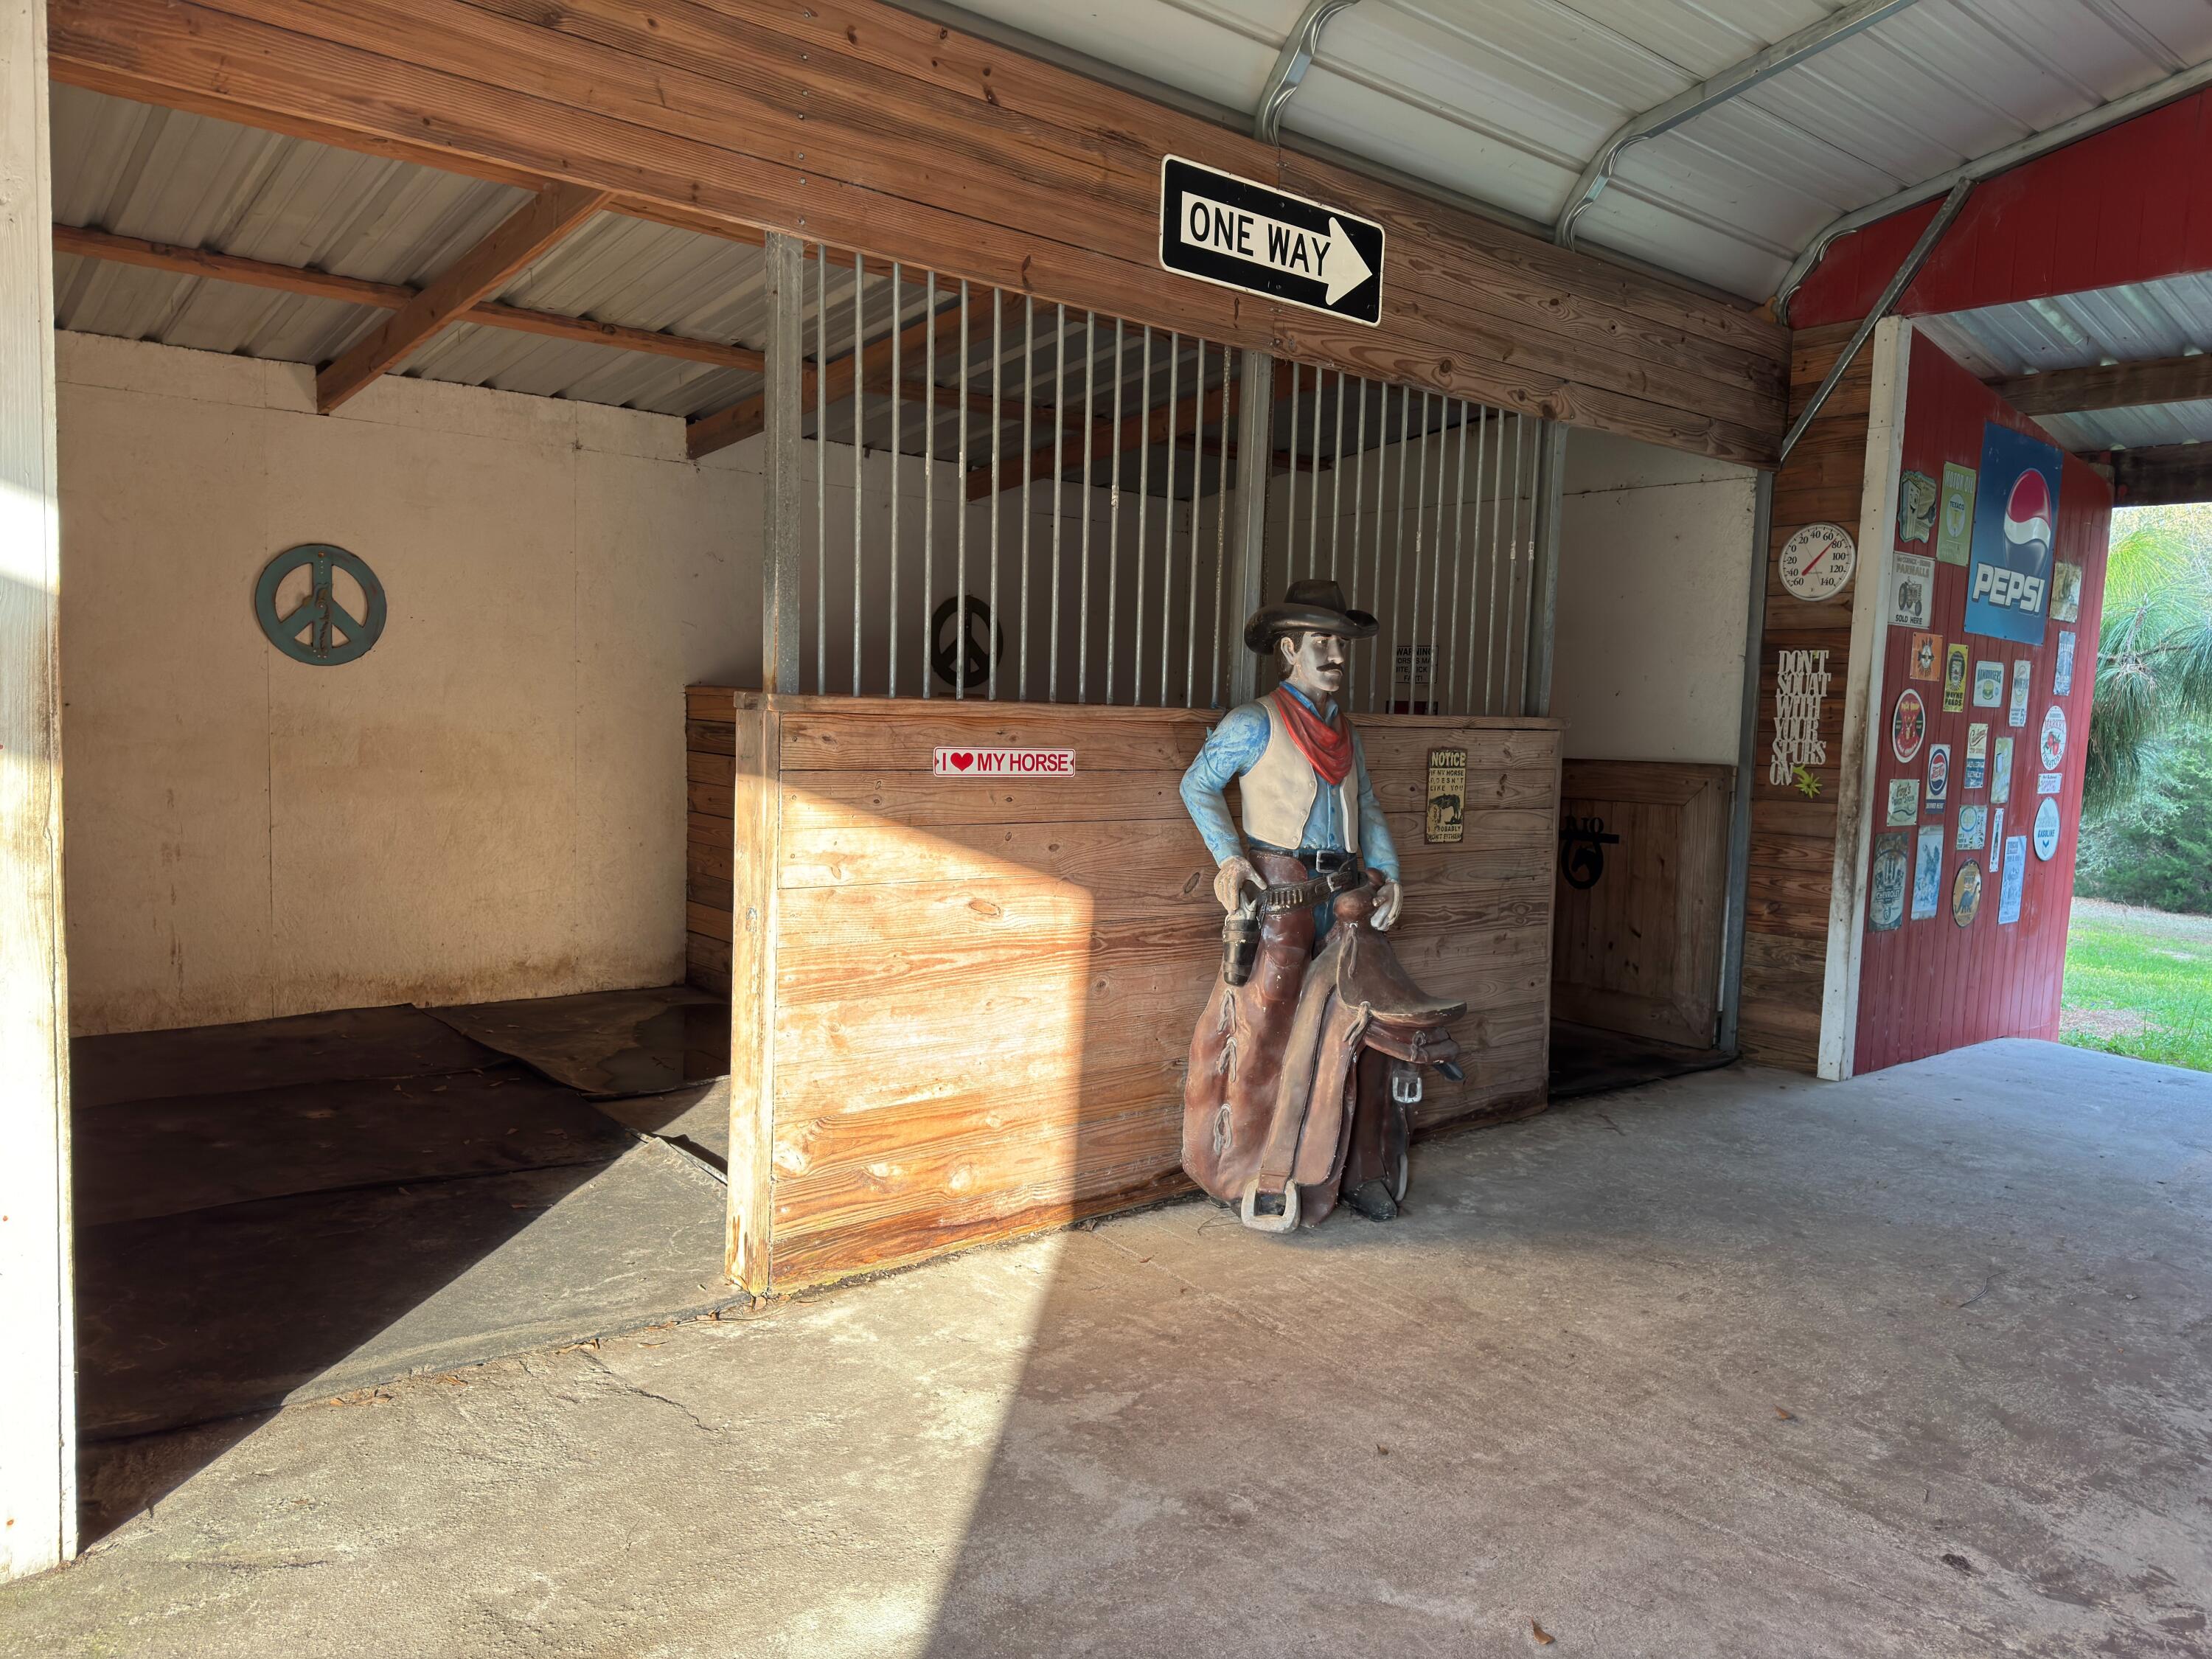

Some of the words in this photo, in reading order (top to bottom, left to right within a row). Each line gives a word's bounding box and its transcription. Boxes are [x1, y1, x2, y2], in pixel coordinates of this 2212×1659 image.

[1189, 202, 1254, 257] ONE
[1268, 223, 1331, 276] WAY
[1945, 470, 1964, 490] MOTOR
[1964, 476, 1974, 494] OIL
[1950, 501, 1965, 511] TEXACO
[1810, 530, 1821, 538] 40
[1823, 532, 1834, 541] 60
[1798, 536, 1809, 544] 20
[1832, 540, 1842, 549] 80
[1832, 552, 1846, 560] 100
[1830, 565, 1844, 573] 120
[1820, 577, 1834, 585] 140
[1972, 563, 2046, 616] PEPSI
[1895, 614, 1909, 624] SOLD
[1910, 616, 1923, 625] HERE
[1778, 650, 1829, 674] DON'T
[1775, 672, 1832, 697] SQUAT
[1945, 691, 1963, 699] WAYNE
[1775, 695, 1822, 720] WITH
[1944, 698, 1962, 706] FEEDS
[1773, 717, 1819, 742] YOUR
[1772, 739, 1826, 765] SPURS
[942, 752, 947, 771] I
[978, 753, 1006, 771] MY
[1009, 753, 1068, 772] HORSE
[1431, 752, 1467, 767] NOTICE
[1770, 761, 1794, 786] ON
[2037, 829, 2055, 838] GASOLINE
[1876, 889, 1900, 900] CHEVROLET
